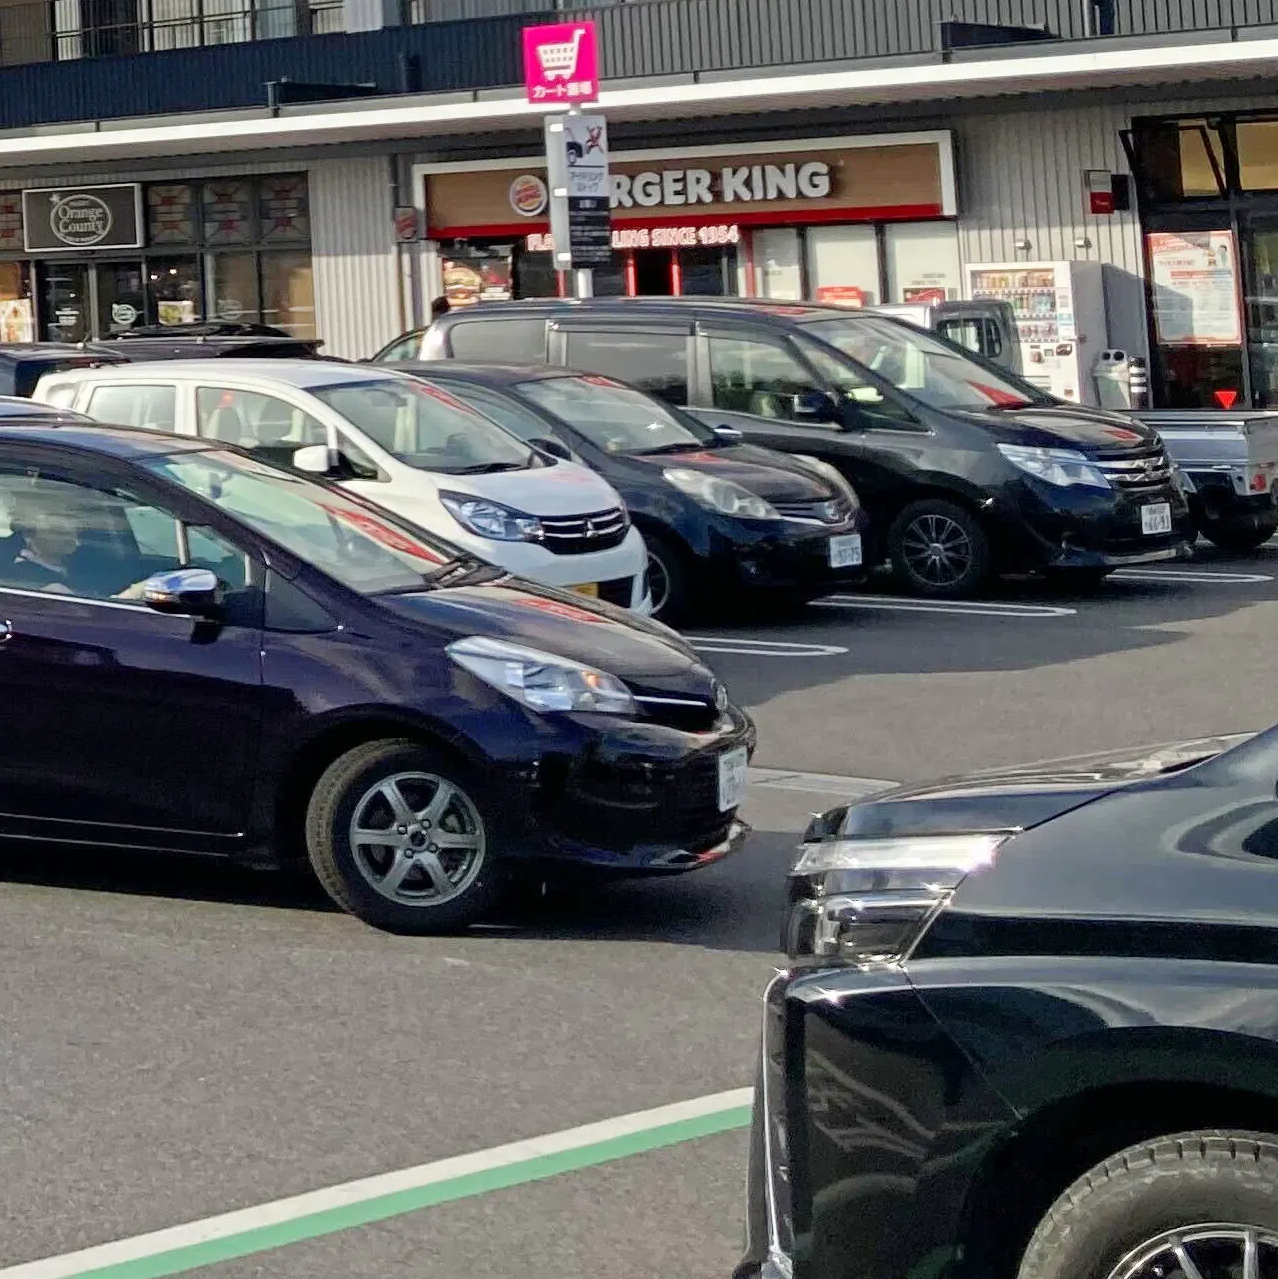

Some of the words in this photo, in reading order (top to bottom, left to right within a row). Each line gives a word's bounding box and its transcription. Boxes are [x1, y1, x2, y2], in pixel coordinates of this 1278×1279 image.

[610, 170, 713, 209] RGER
[722, 161, 832, 203] KING
[58, 205, 104, 222] Orange
[58, 218, 105, 236] County
[526, 233, 557, 252] FLA
[651, 227, 697, 247] SINCE
[698, 225, 739, 245] 1954
